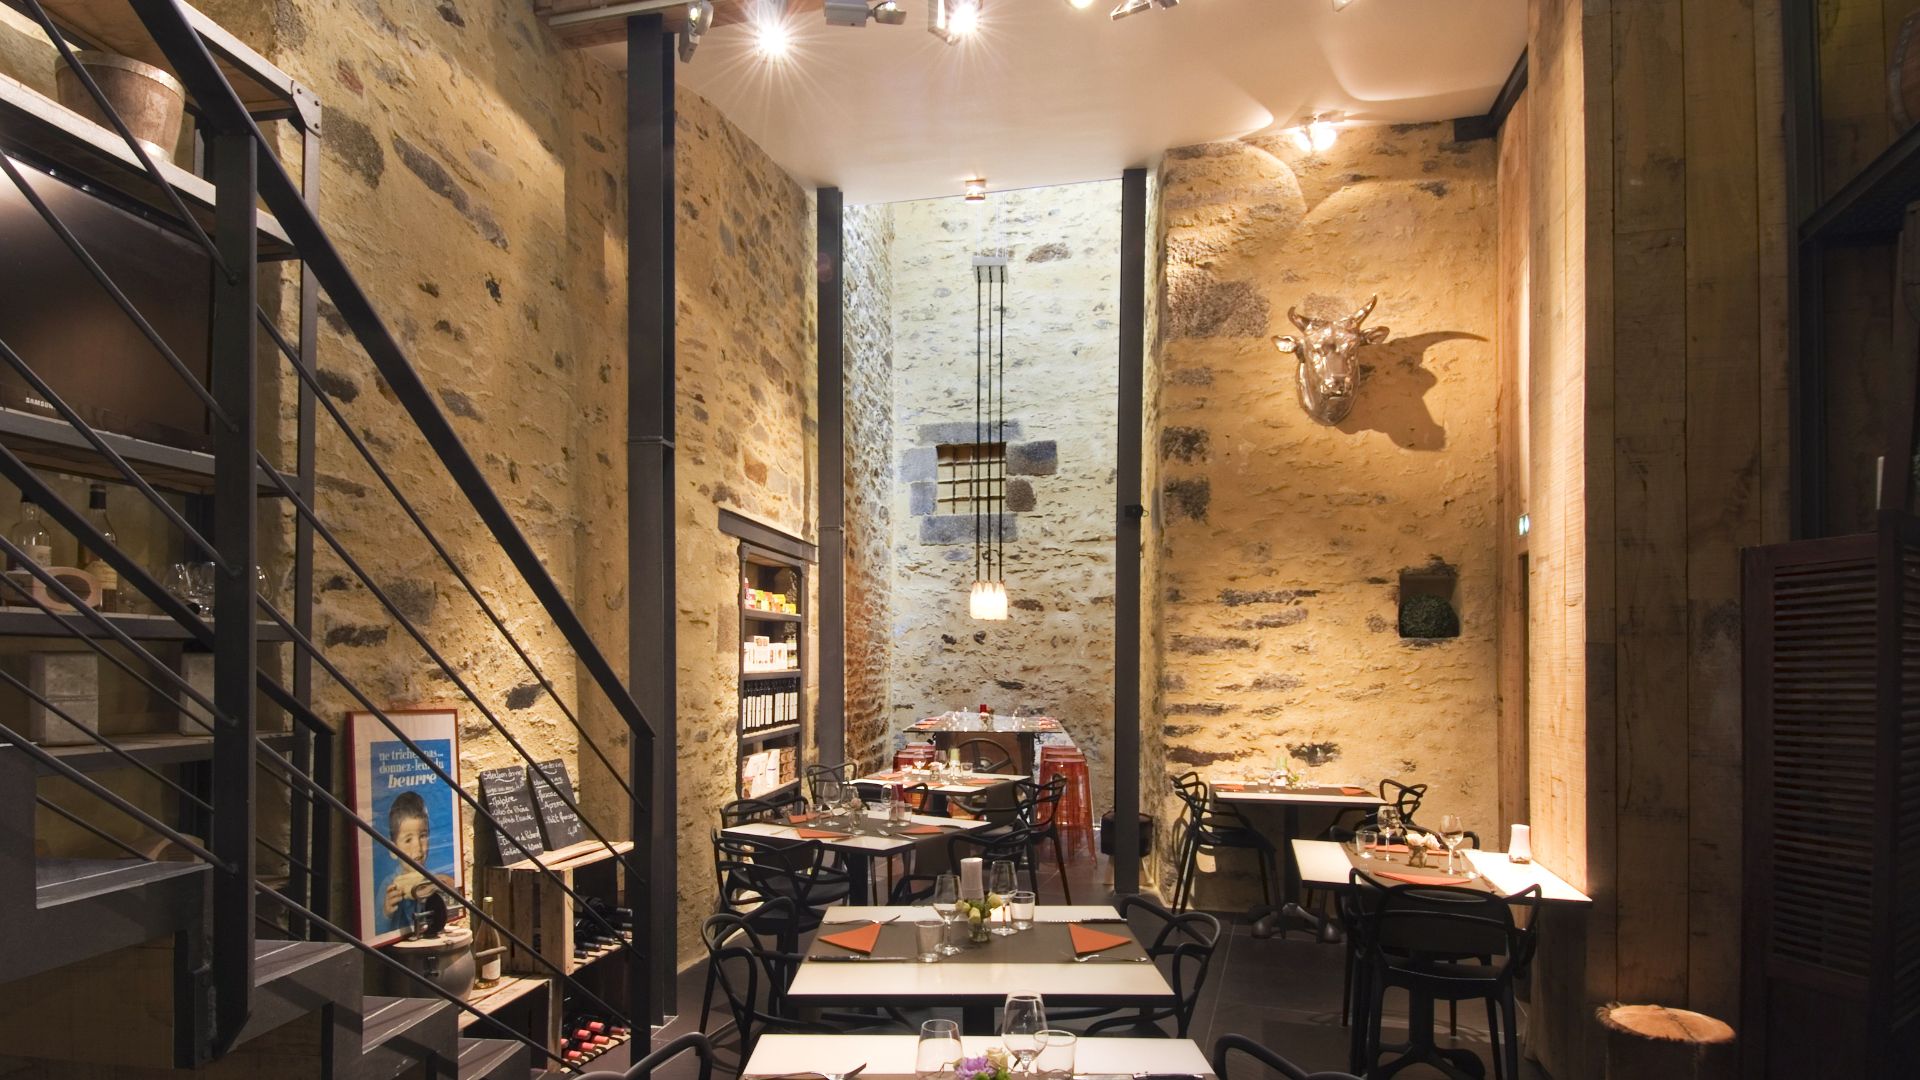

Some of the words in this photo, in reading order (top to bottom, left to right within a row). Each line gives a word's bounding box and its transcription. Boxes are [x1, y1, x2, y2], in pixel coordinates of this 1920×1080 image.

[25, 397, 55, 409] SAMSUN
[379, 752, 390, 761] ne
[379, 759, 431, 774] donnez-leu
[388, 773, 437, 789] beurre
